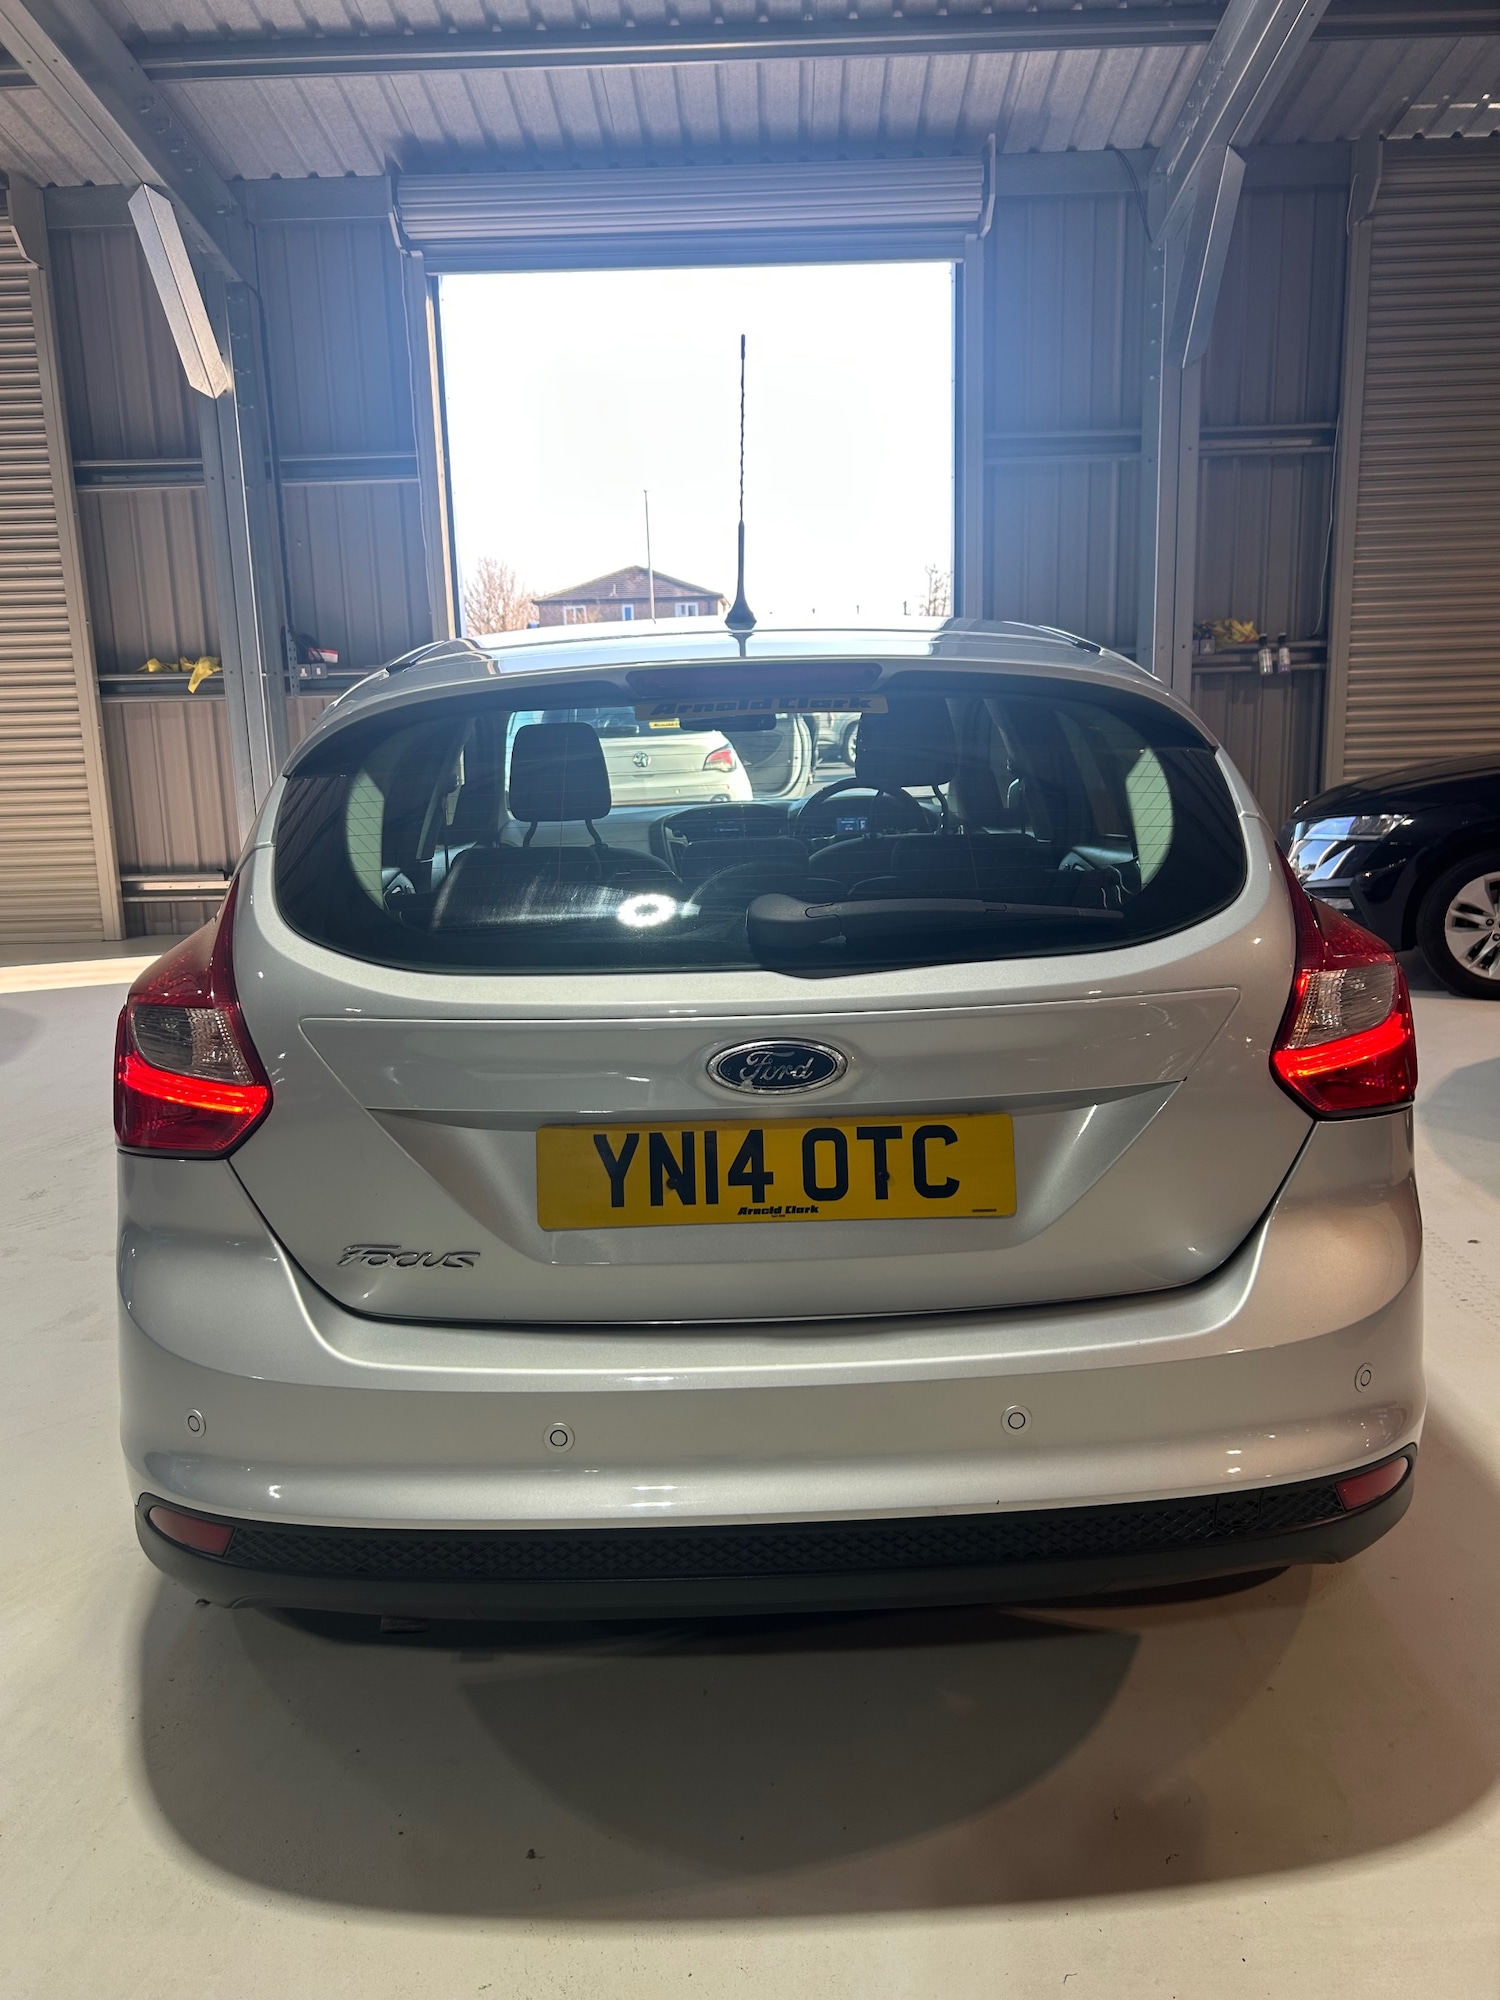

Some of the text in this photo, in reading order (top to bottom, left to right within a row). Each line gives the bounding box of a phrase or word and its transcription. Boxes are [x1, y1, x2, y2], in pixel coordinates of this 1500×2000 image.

[650, 696, 873, 715] Arnold Clark
[740, 1051, 814, 1080] Ford
[593, 1124, 960, 1208] YN14 OTC
[737, 1205, 819, 1215] Arnold Clark
